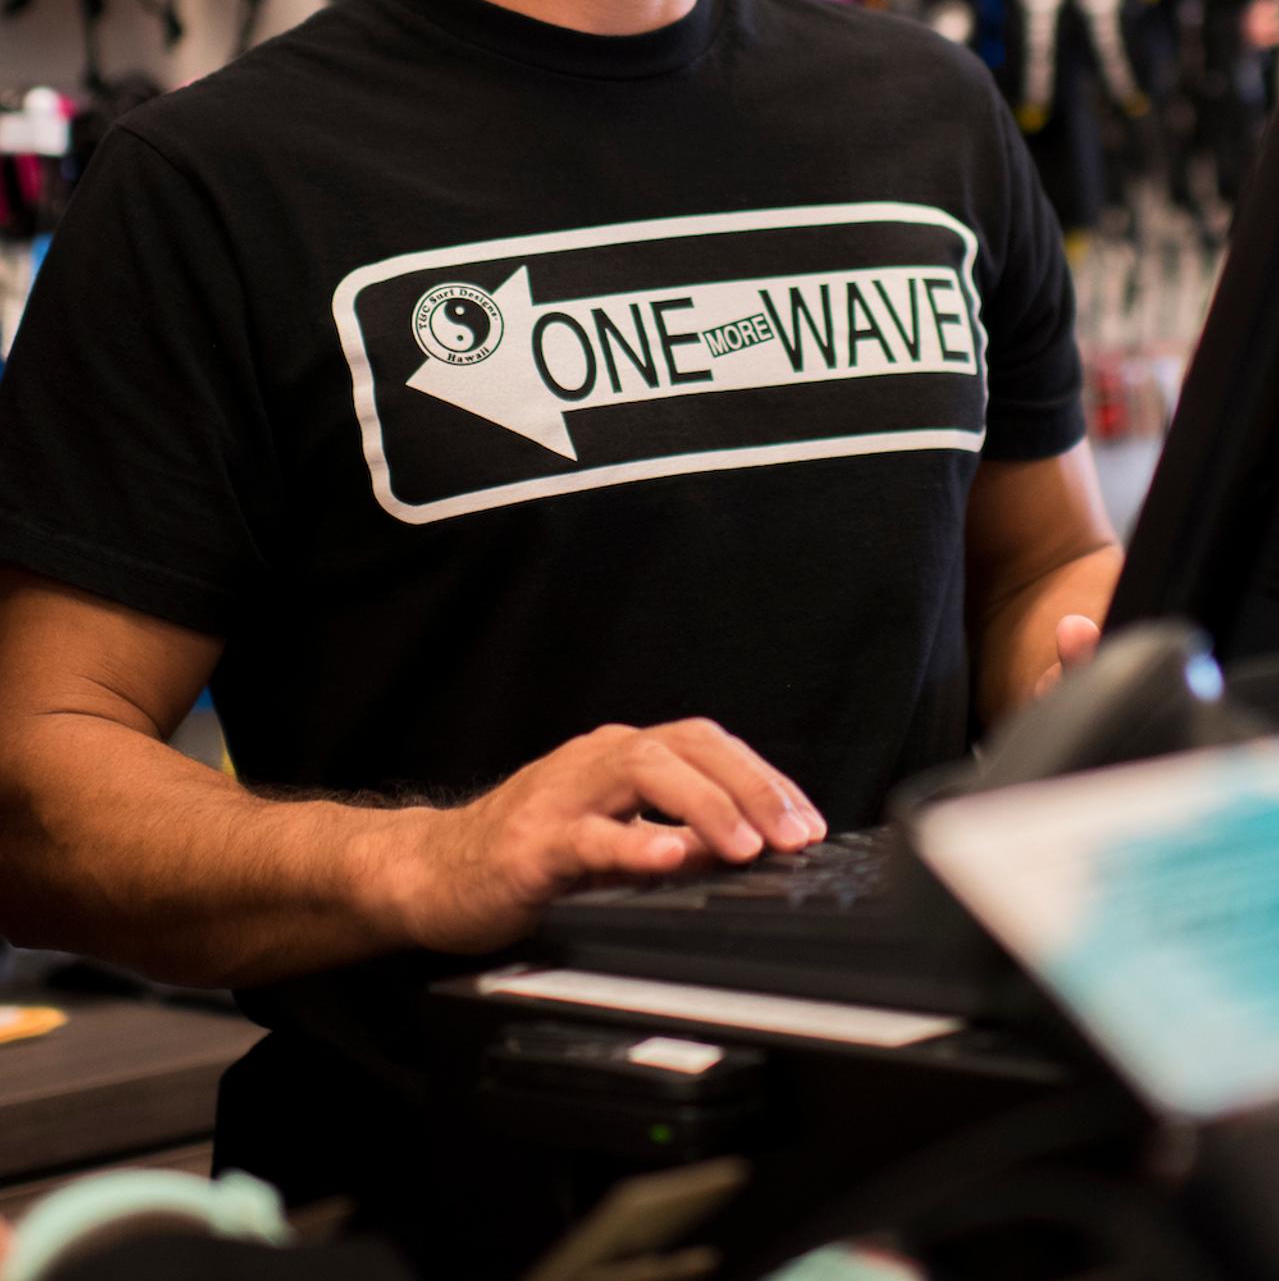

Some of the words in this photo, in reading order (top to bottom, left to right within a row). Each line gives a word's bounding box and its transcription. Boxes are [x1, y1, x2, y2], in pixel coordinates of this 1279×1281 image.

[429, 289, 455, 305] Surf
[459, 288, 498, 318] Designs
[447, 346, 490, 363] Hawaii
[532, 297, 713, 402] ONE
[705, 316, 772, 356] MORE
[758, 278, 970, 373] WAVE
